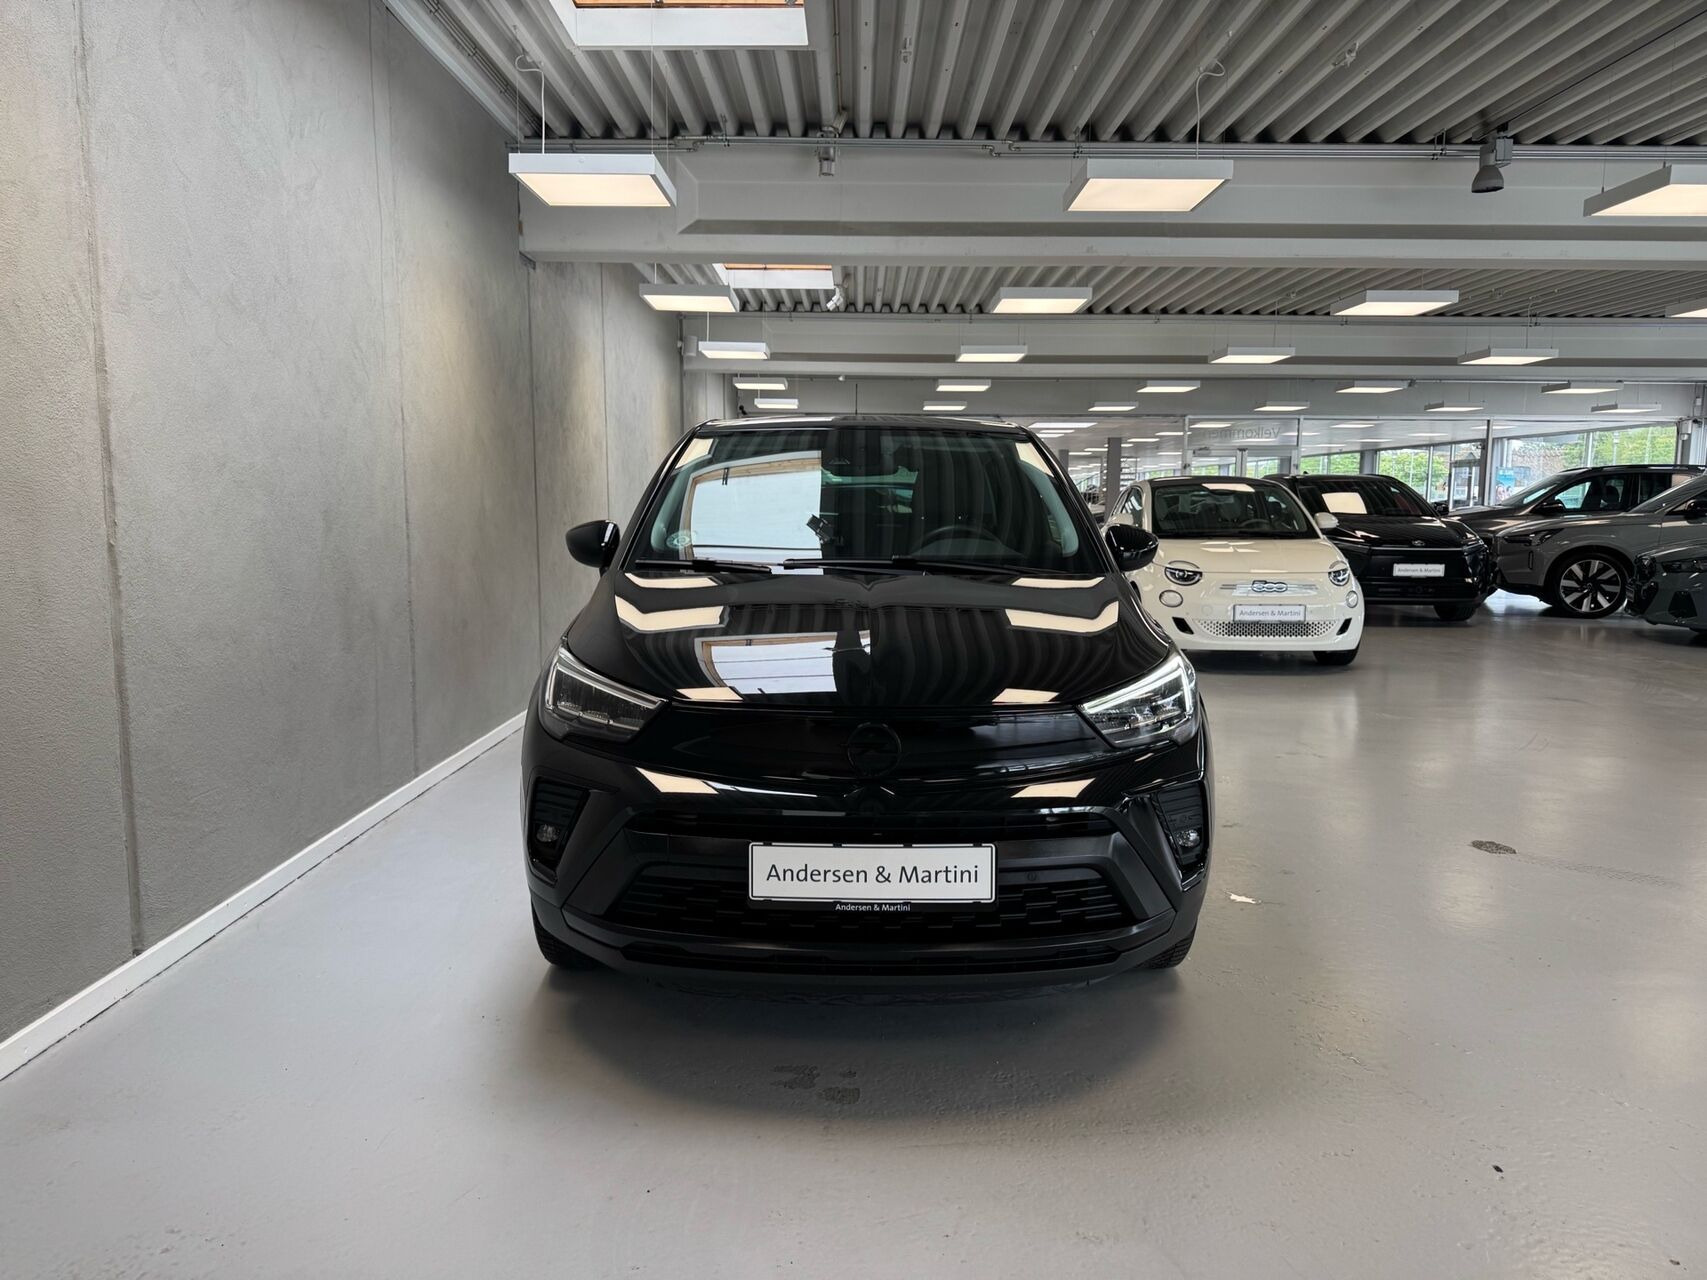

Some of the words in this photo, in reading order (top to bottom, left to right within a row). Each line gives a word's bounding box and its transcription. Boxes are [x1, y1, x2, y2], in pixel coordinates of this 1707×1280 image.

[1252, 579, 1288, 592] 500
[1239, 609, 1269, 617] Andersen
[1277, 609, 1301, 617] Martini
[766, 863, 868, 883] Andersen
[875, 865, 892, 884] &
[898, 864, 979, 884] Martini
[835, 903, 872, 911] Andersen
[873, 903, 880, 911] &
[881, 903, 911, 912] Martini
